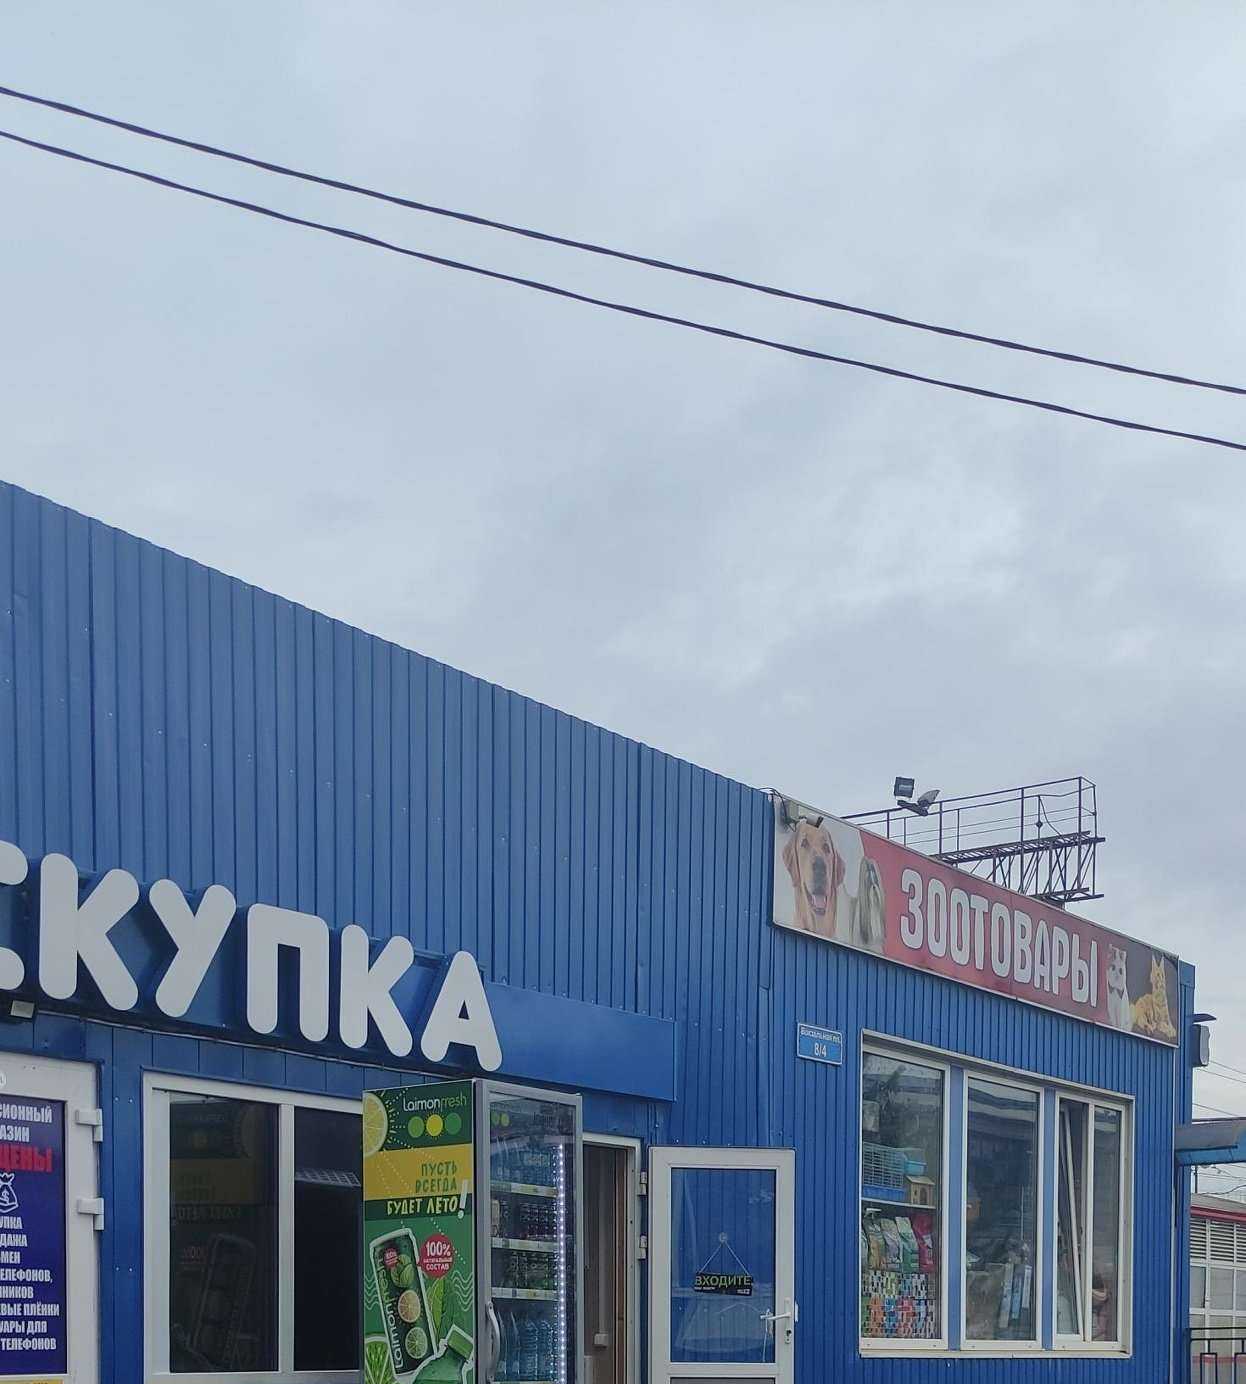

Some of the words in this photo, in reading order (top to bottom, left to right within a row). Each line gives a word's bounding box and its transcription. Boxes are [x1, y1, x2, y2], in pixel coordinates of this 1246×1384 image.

[900, 868, 1098, 1009] ЗООТОВАРЫ
[814, 1042, 827, 1058] 8/4
[421, 1161, 457, 1177] ПУСТЬ
[387, 1199, 422, 1215] БУДЕТ
[425, 1241, 451, 1257] 100%
[0, 1251, 21, 1264] МЕН
[425, 1263, 450, 1271] СОСТАВ
[0, 1268, 53, 1283] ЕЛЕФОНОВ,
[695, 1275, 752, 1289] ВХОДИТЕ
[24, 1301, 60, 1317] ПЛЁНКИ
[27, 1321, 48, 1336] ДЛЯ
[1, 1338, 57, 1351] ТЕЛЕФОНОВ
